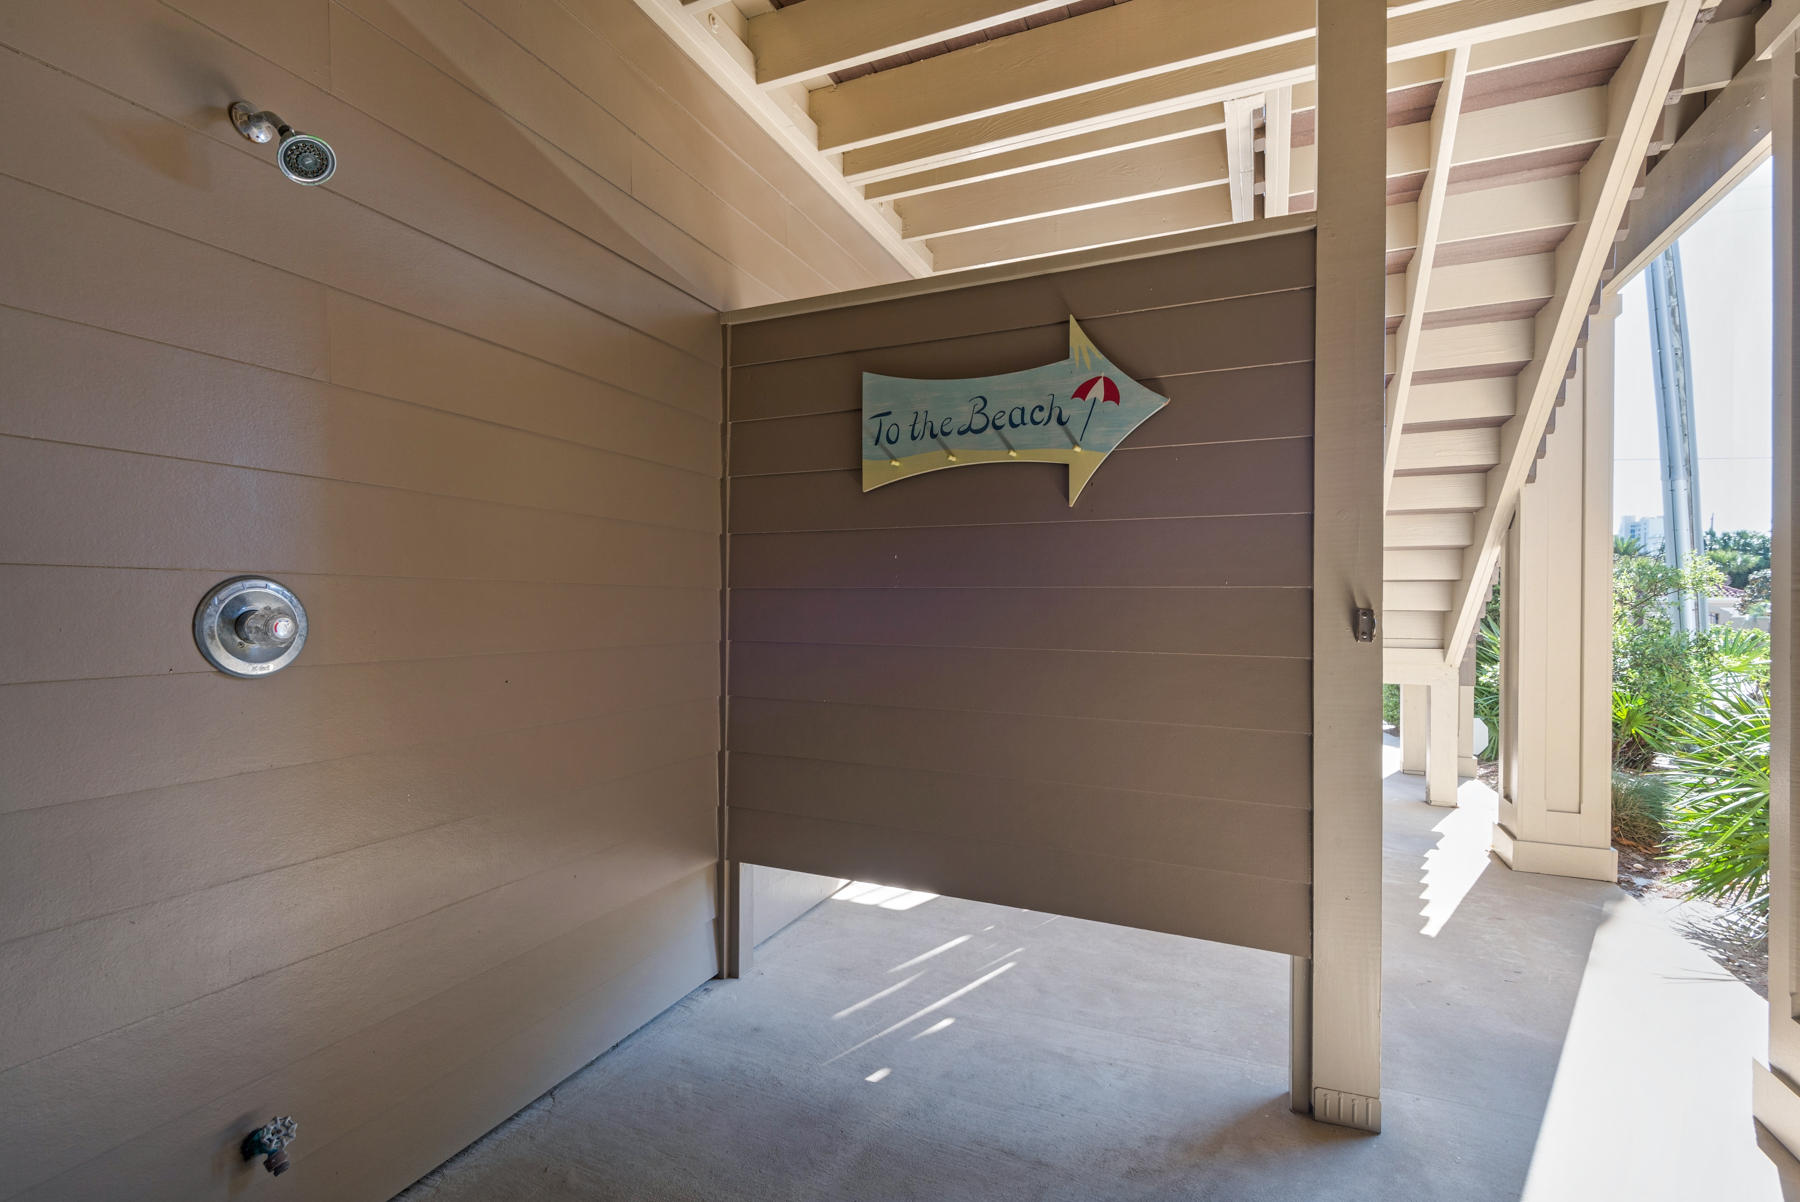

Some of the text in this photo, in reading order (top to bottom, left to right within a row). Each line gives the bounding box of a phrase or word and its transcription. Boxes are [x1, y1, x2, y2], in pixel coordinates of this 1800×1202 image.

[869, 393, 1071, 446] To the Beach
